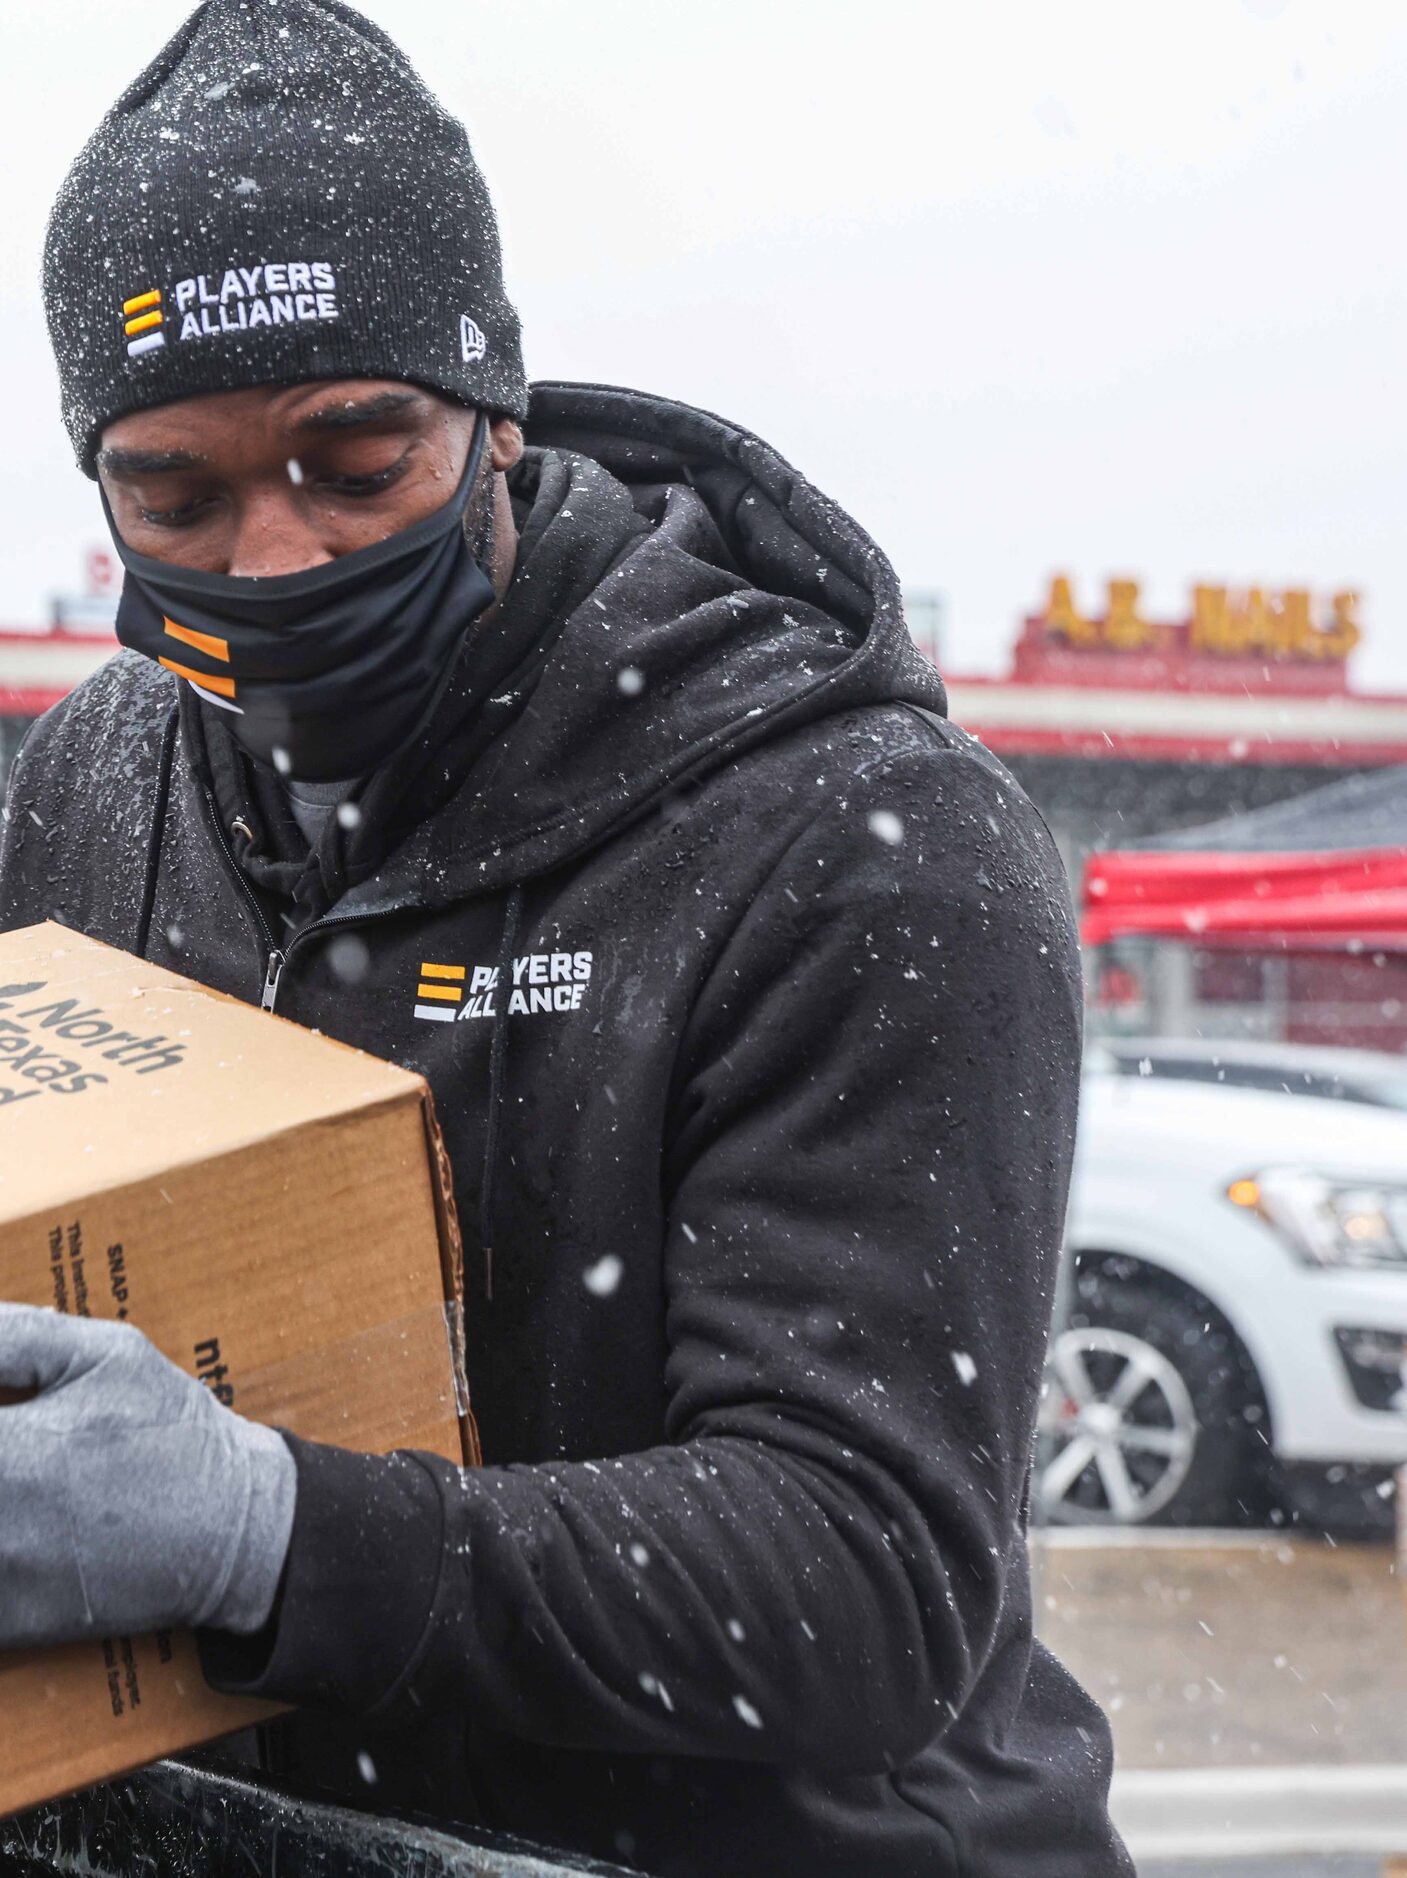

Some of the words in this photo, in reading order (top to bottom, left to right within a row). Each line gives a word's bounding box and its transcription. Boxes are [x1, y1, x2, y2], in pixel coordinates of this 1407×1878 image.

[175, 261, 336, 312] PLAYERS
[180, 293, 340, 341] ALLIANCE
[469, 951, 593, 994] PLYERS
[457, 983, 586, 1021] ALLANCE
[17, 998, 188, 1075] North
[107, 1242, 129, 1303] SNAP
